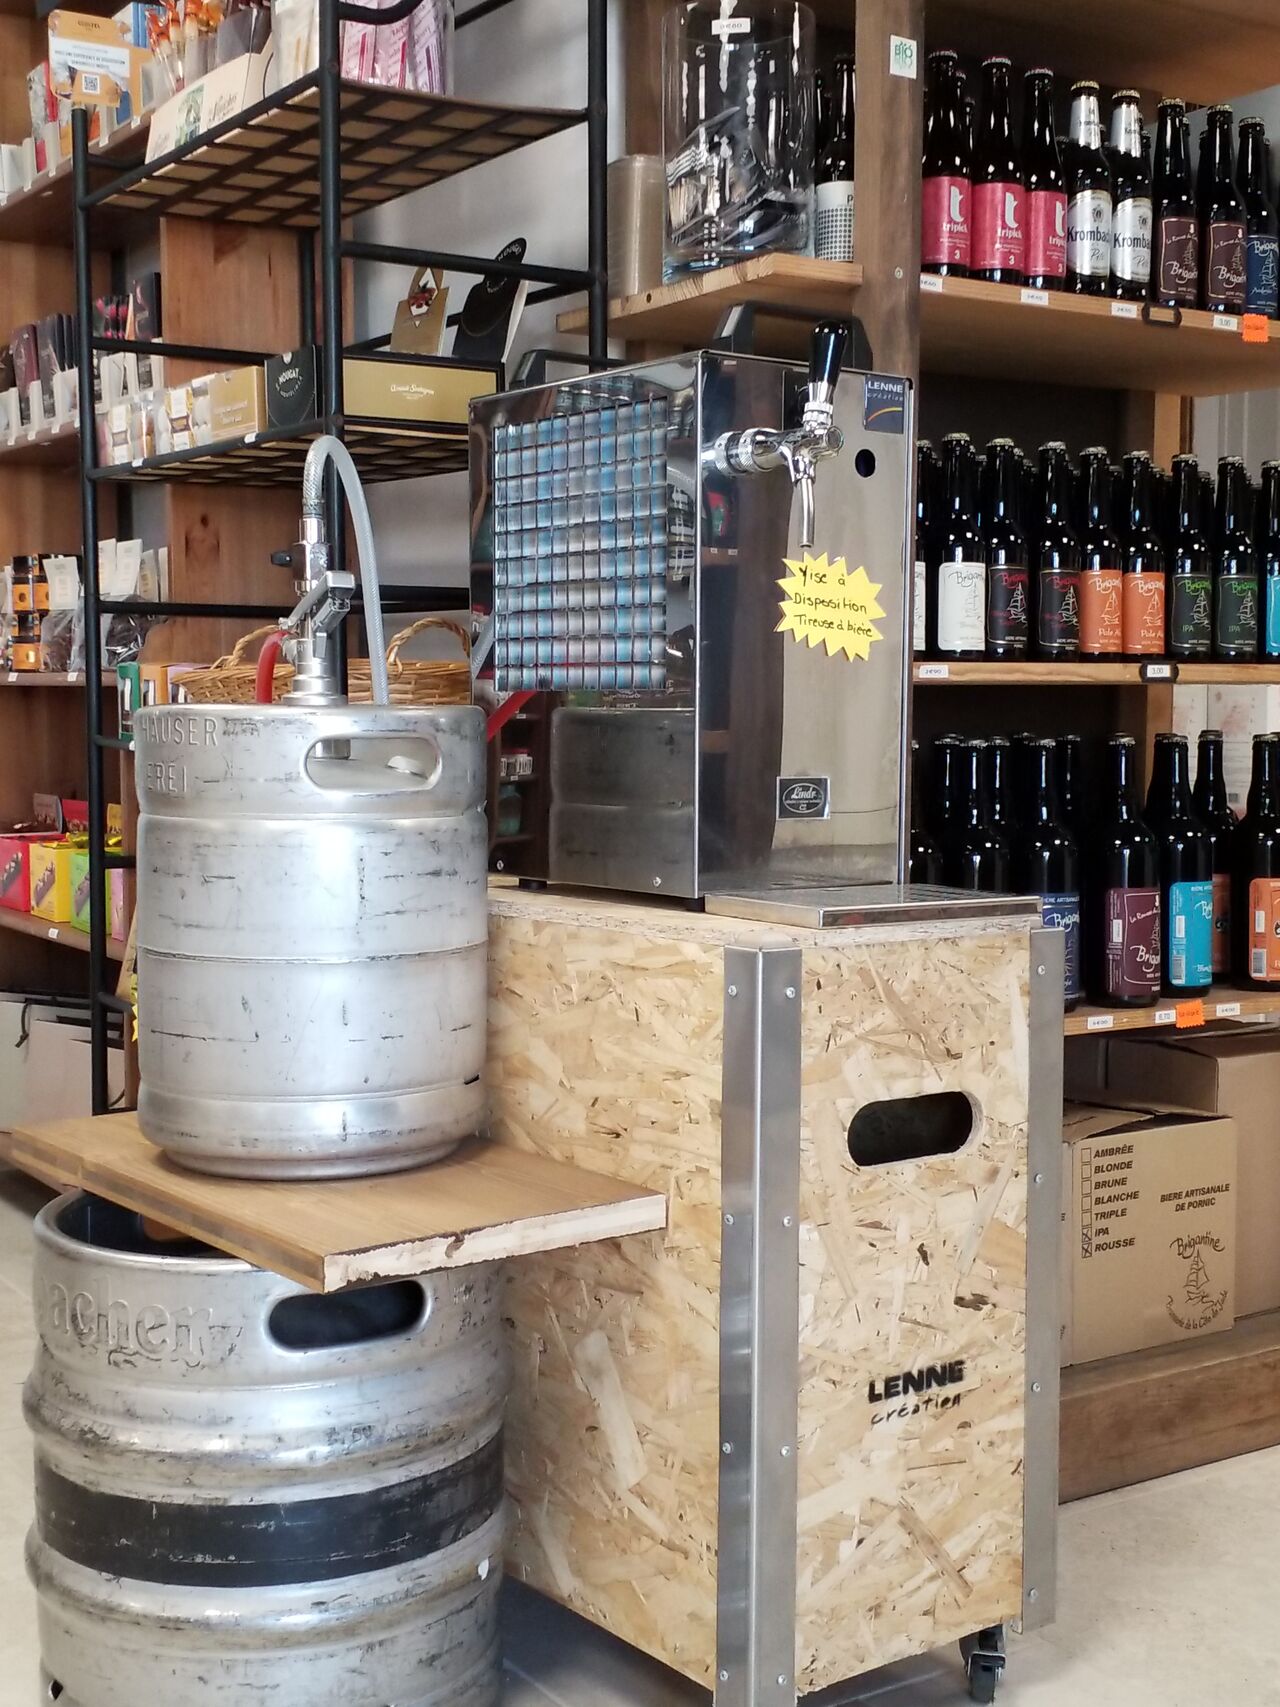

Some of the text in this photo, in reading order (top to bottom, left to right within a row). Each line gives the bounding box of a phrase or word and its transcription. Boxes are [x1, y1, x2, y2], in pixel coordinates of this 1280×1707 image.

[868, 380, 903, 393] LENNE
[793, 592, 867, 615] Disposition
[793, 614, 873, 637] Tireuse à bière
[1183, 624, 1194, 632] IPA
[1093, 1144, 1134, 1159] AMBRÉE
[1094, 1160, 1133, 1174] BLONDE
[1094, 1177, 1128, 1190] BRUNE
[1184, 1183, 1230, 1199] ARTISANALE
[1094, 1191, 1140, 1206] BLANCHE
[1175, 1197, 1216, 1212] DE PORNIC
[1094, 1208, 1127, 1221] TRIPLE
[1095, 1227, 1110, 1237] IPA
[1095, 1238, 1136, 1252] ROUSSE
[868, 1359, 965, 1404] LENNE
